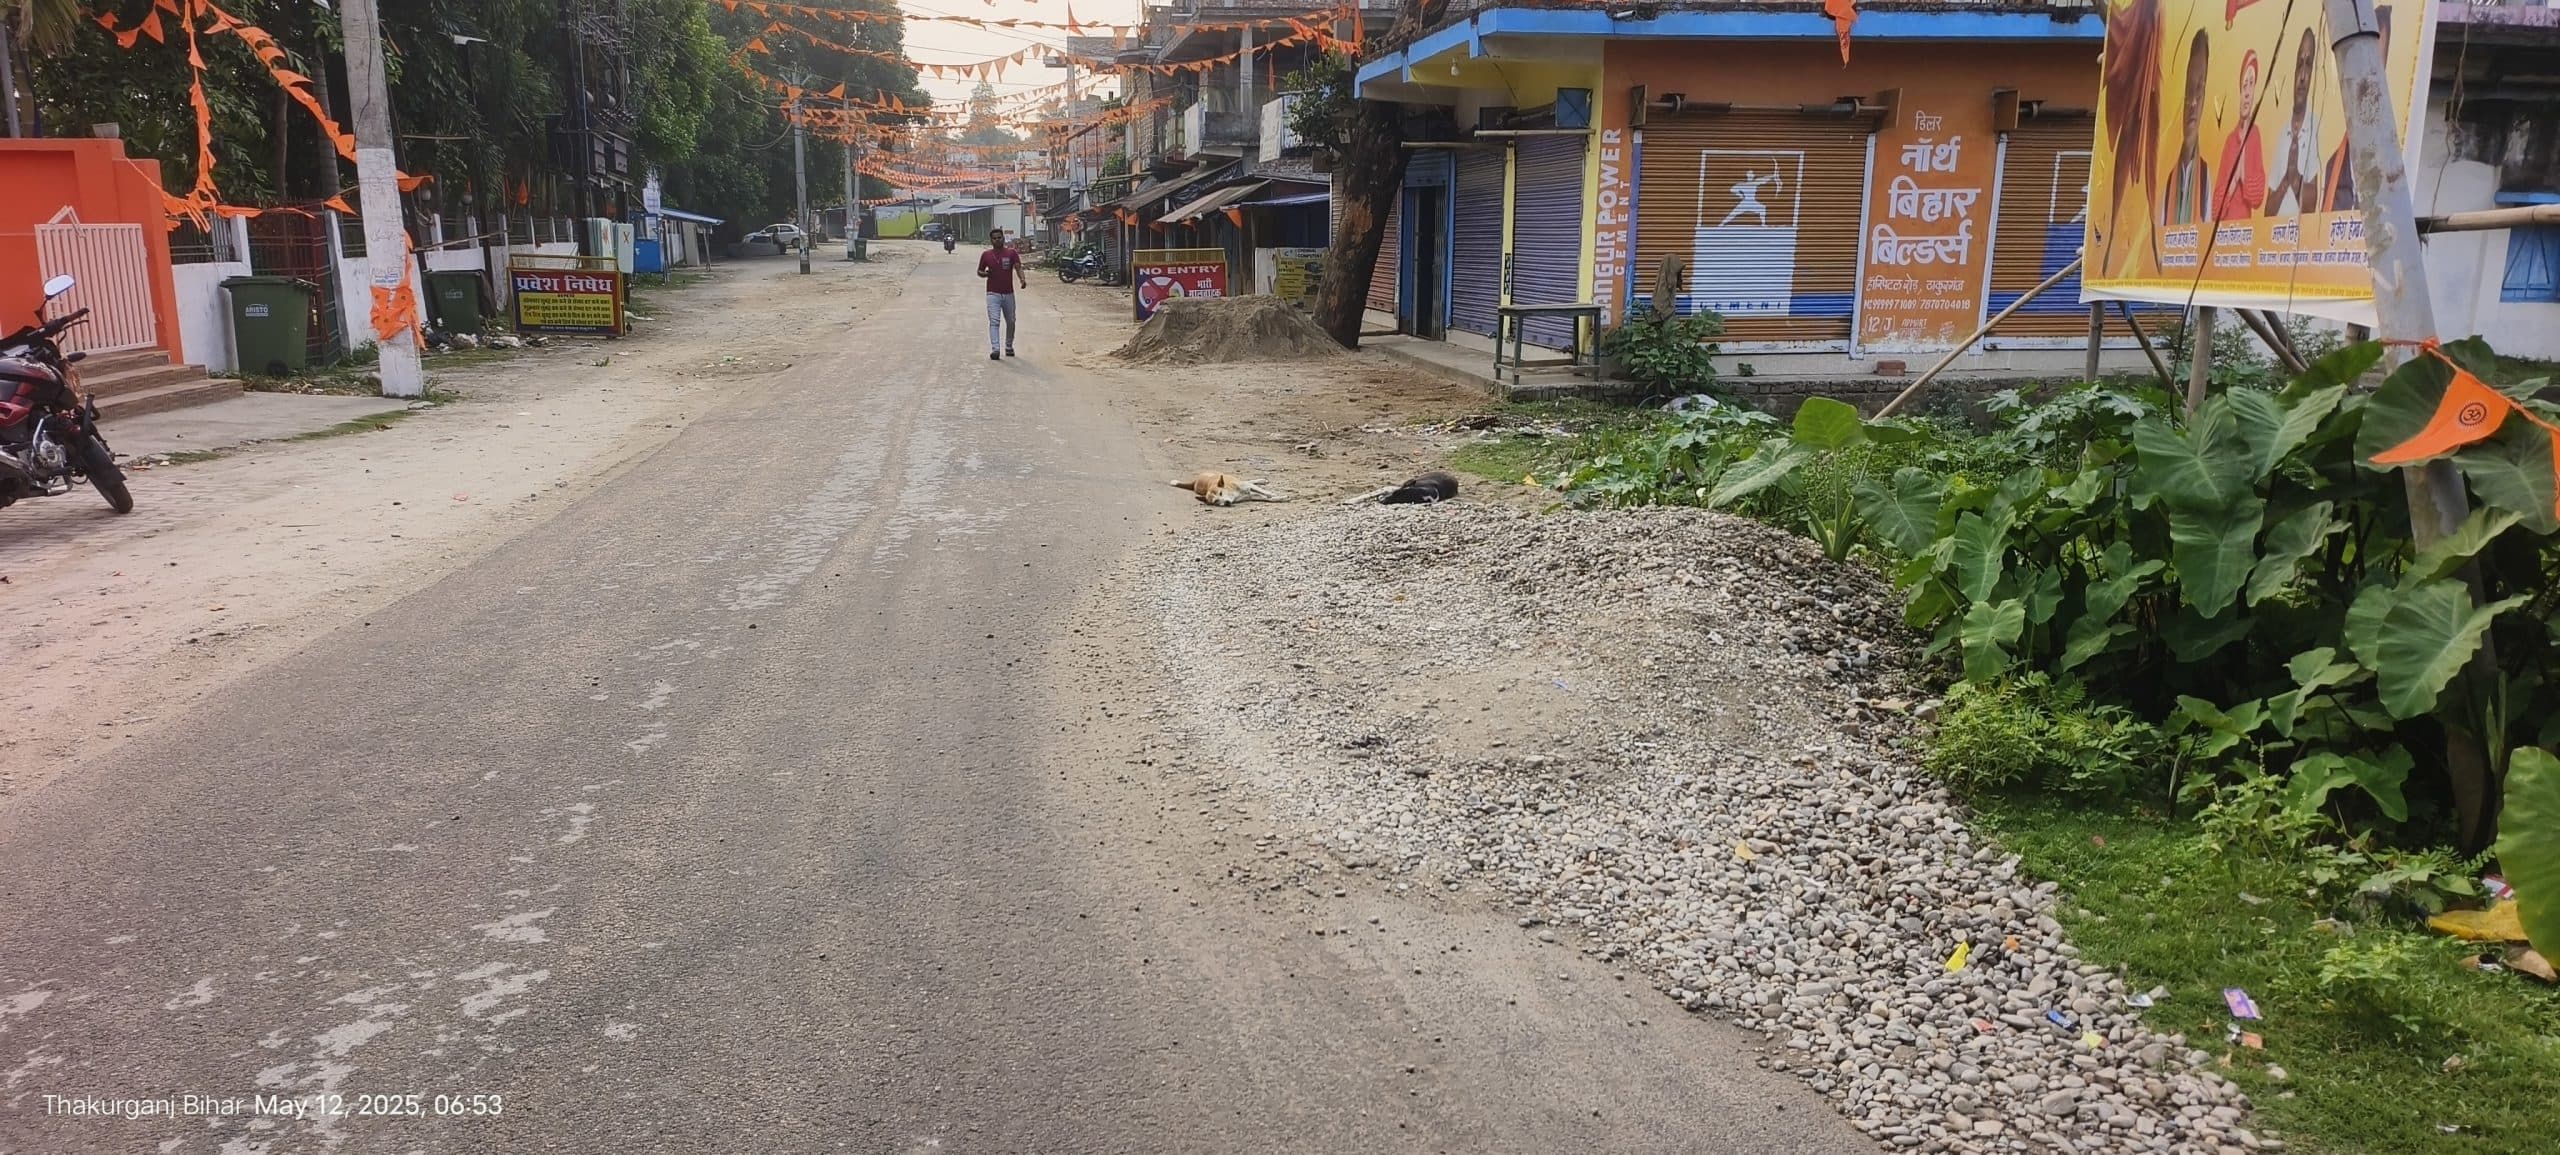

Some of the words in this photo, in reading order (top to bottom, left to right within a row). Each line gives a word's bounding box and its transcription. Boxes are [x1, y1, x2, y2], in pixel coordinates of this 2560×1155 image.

[1915, 110, 1942, 132] डिलर
[1901, 136, 1961, 173] नॉर्थ
[1598, 127, 1622, 225] POWER
[1888, 175, 1982, 223] बिहार
[1614, 181, 1630, 276] CEMENT
[1871, 219, 1973, 265] बिल्डर्स
[516, 274, 560, 291] प्रवेश
[564, 275, 613, 292] निषेध
[1139, 267, 1162, 275] NO
[1167, 265, 1220, 275] ENTRY
[1197, 277, 1212, 289] भारी
